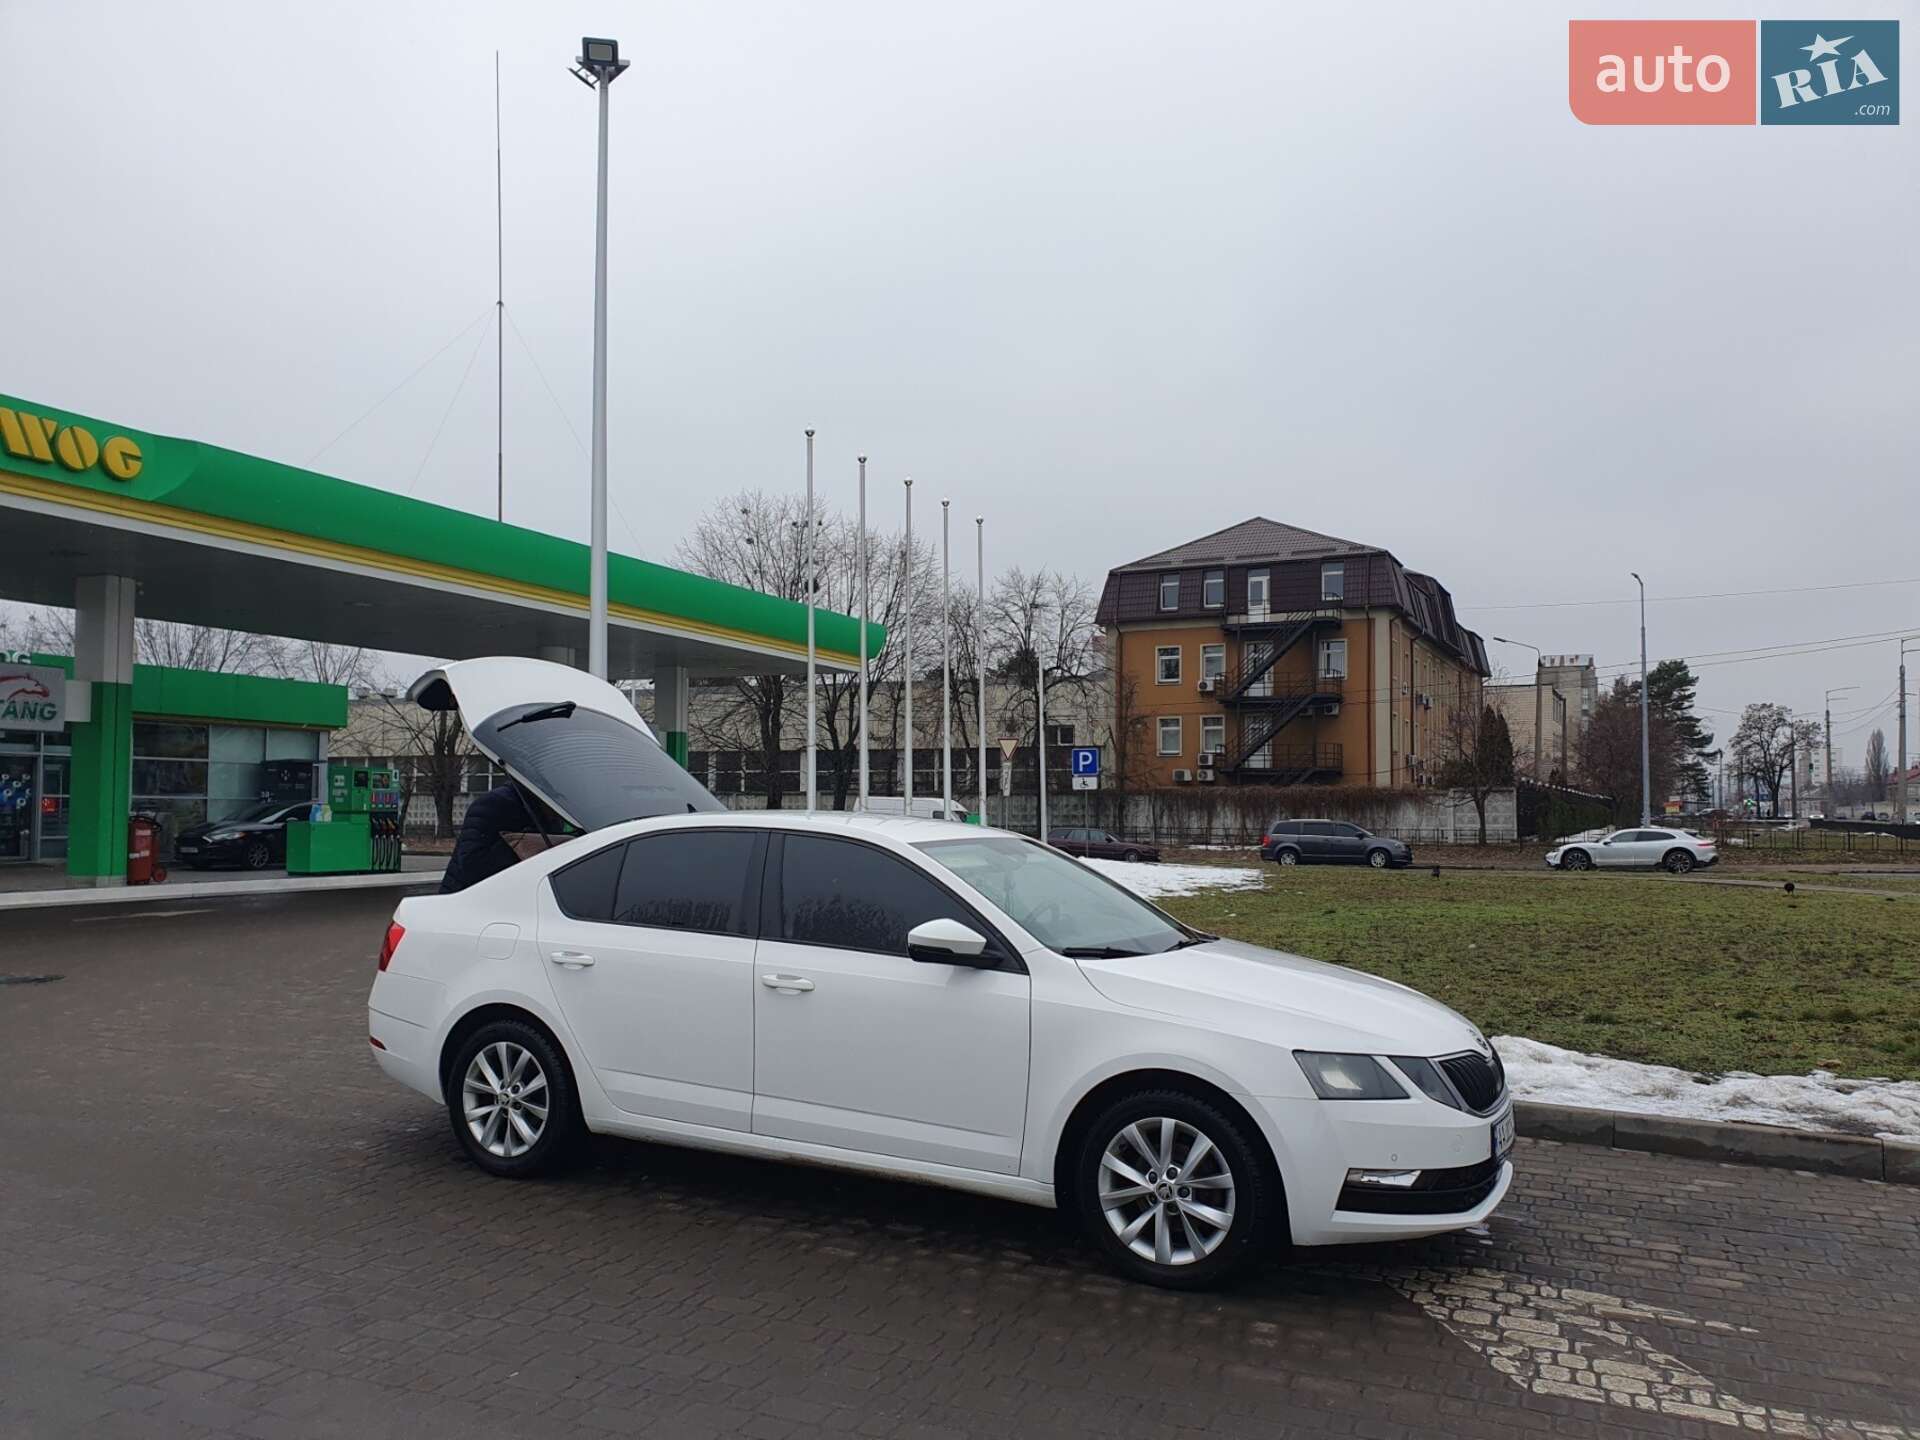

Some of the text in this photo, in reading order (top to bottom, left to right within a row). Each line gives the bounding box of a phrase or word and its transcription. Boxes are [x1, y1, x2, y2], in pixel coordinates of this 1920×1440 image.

[0, 406, 143, 479] WOG
[0, 700, 57, 721] ANG
[1079, 751, 1093, 772] P
